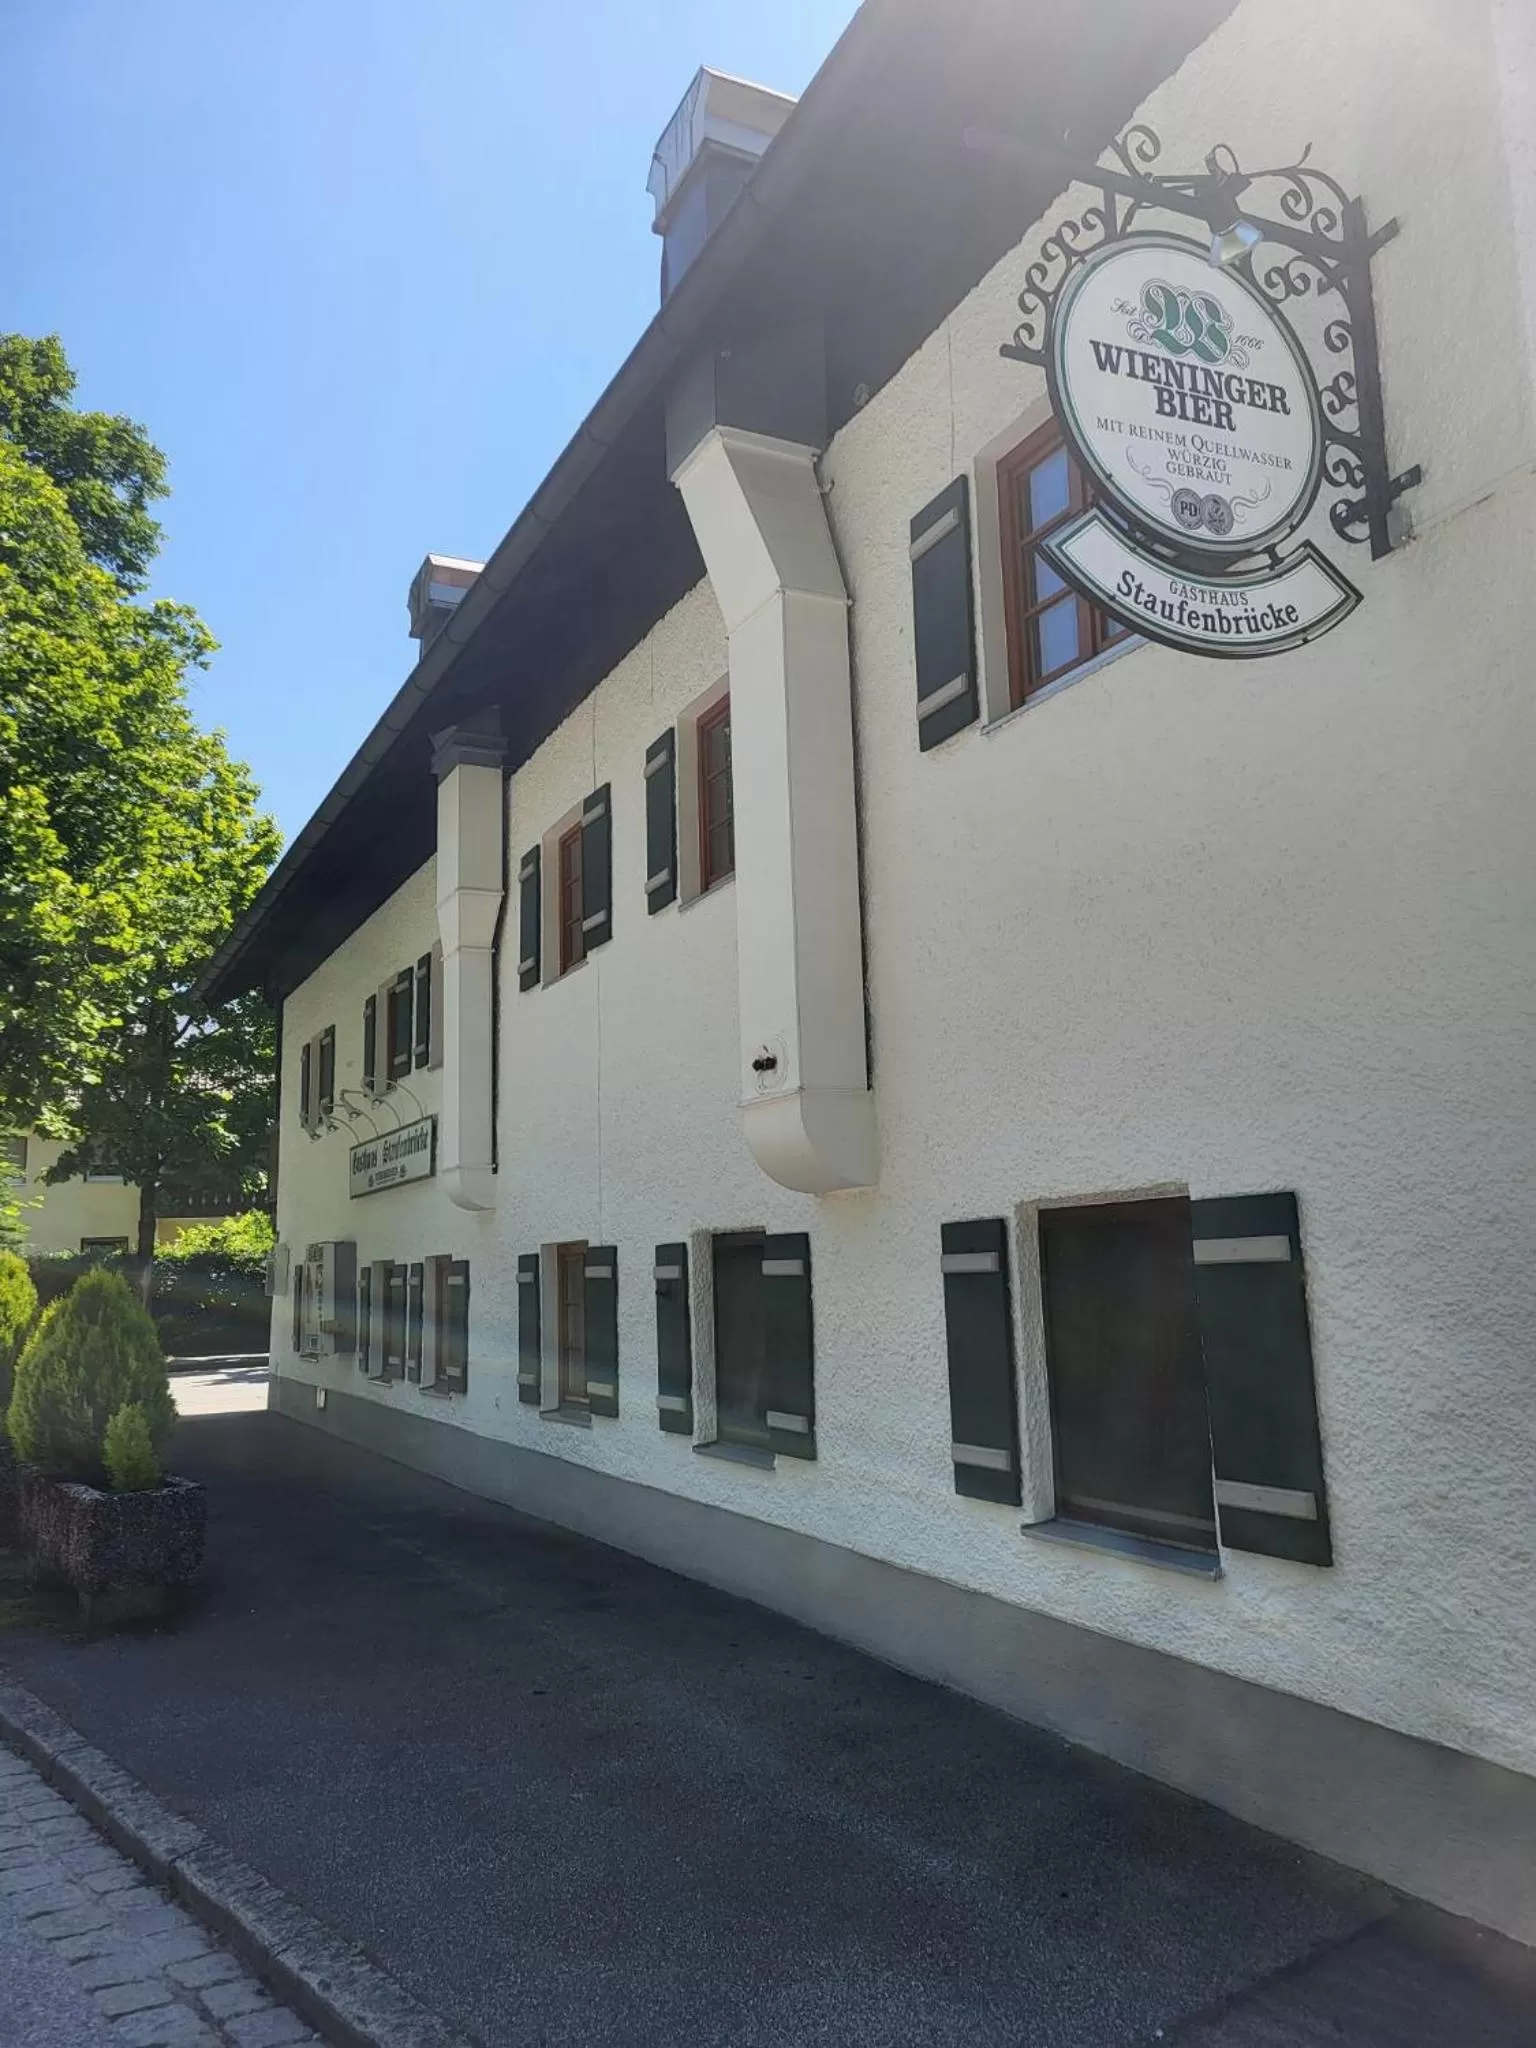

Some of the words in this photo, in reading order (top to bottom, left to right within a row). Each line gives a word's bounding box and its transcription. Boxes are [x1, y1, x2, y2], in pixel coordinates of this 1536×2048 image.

[1089, 340, 1291, 415] WIENINGER
[1153, 385, 1237, 432] BIER
[1096, 416, 1124, 434] MIT
[1129, 424, 1187, 447] REINEM
[1191, 434, 1293, 470] QUELLWASSER
[1167, 448, 1227, 471] WÜRZIG
[1166, 461, 1233, 485] GEBRAUT
[1116, 570, 1299, 635] Staufenbrücke
[1169, 581, 1249, 606] GASTHAUS
